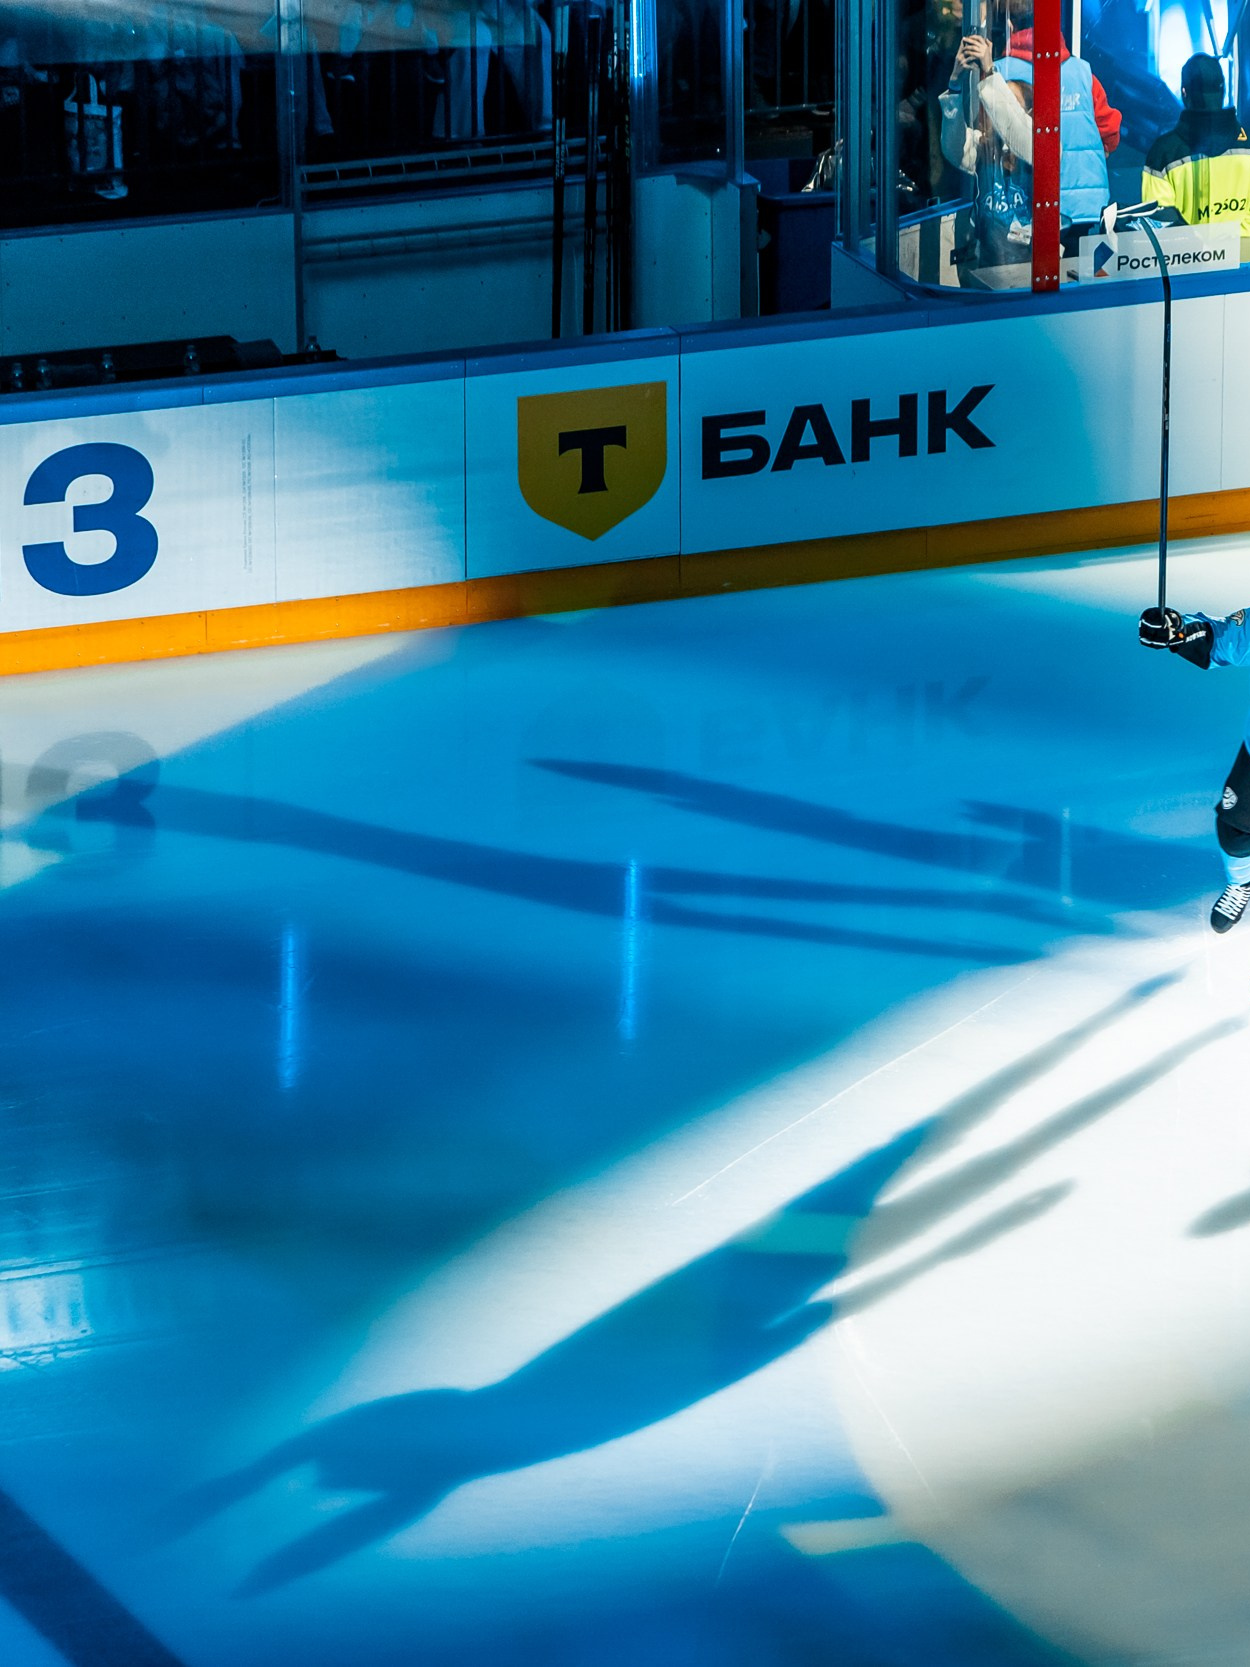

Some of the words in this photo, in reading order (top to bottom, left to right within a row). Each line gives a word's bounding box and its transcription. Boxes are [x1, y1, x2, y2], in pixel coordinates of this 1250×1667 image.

[1117, 249, 1226, 271] Ростелеком
[558, 425, 627, 494] Т
[702, 383, 996, 480] БАНК
